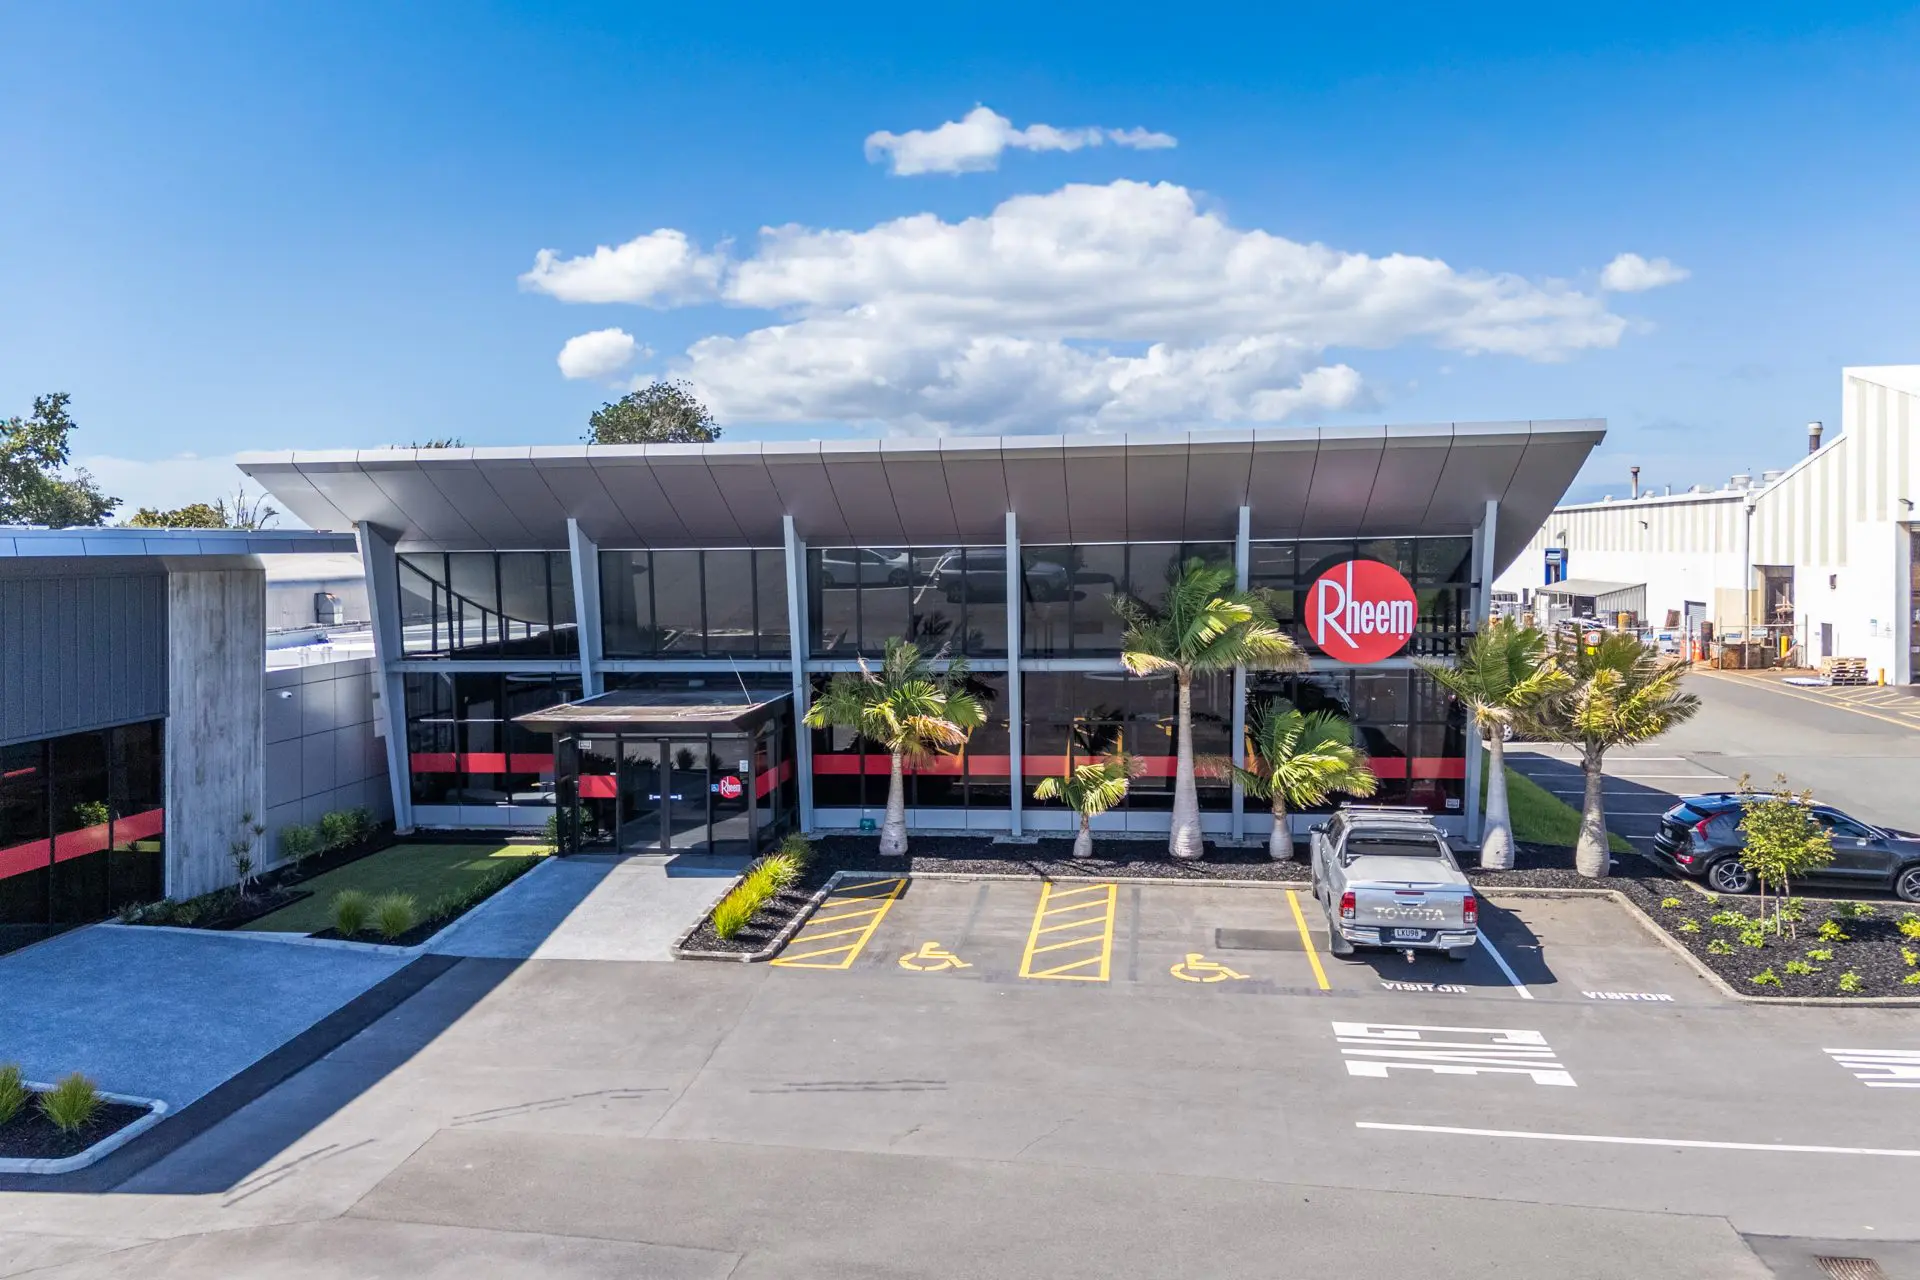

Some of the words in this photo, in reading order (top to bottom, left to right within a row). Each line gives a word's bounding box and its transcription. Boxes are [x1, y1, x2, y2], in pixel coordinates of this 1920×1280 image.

[1317, 560, 1413, 649] Rheem
[721, 776, 741, 796] Rheem
[1374, 906, 1445, 921] TOYOTA
[1381, 982, 1468, 993] VISITOR
[1582, 991, 1675, 1001] VISITOR
